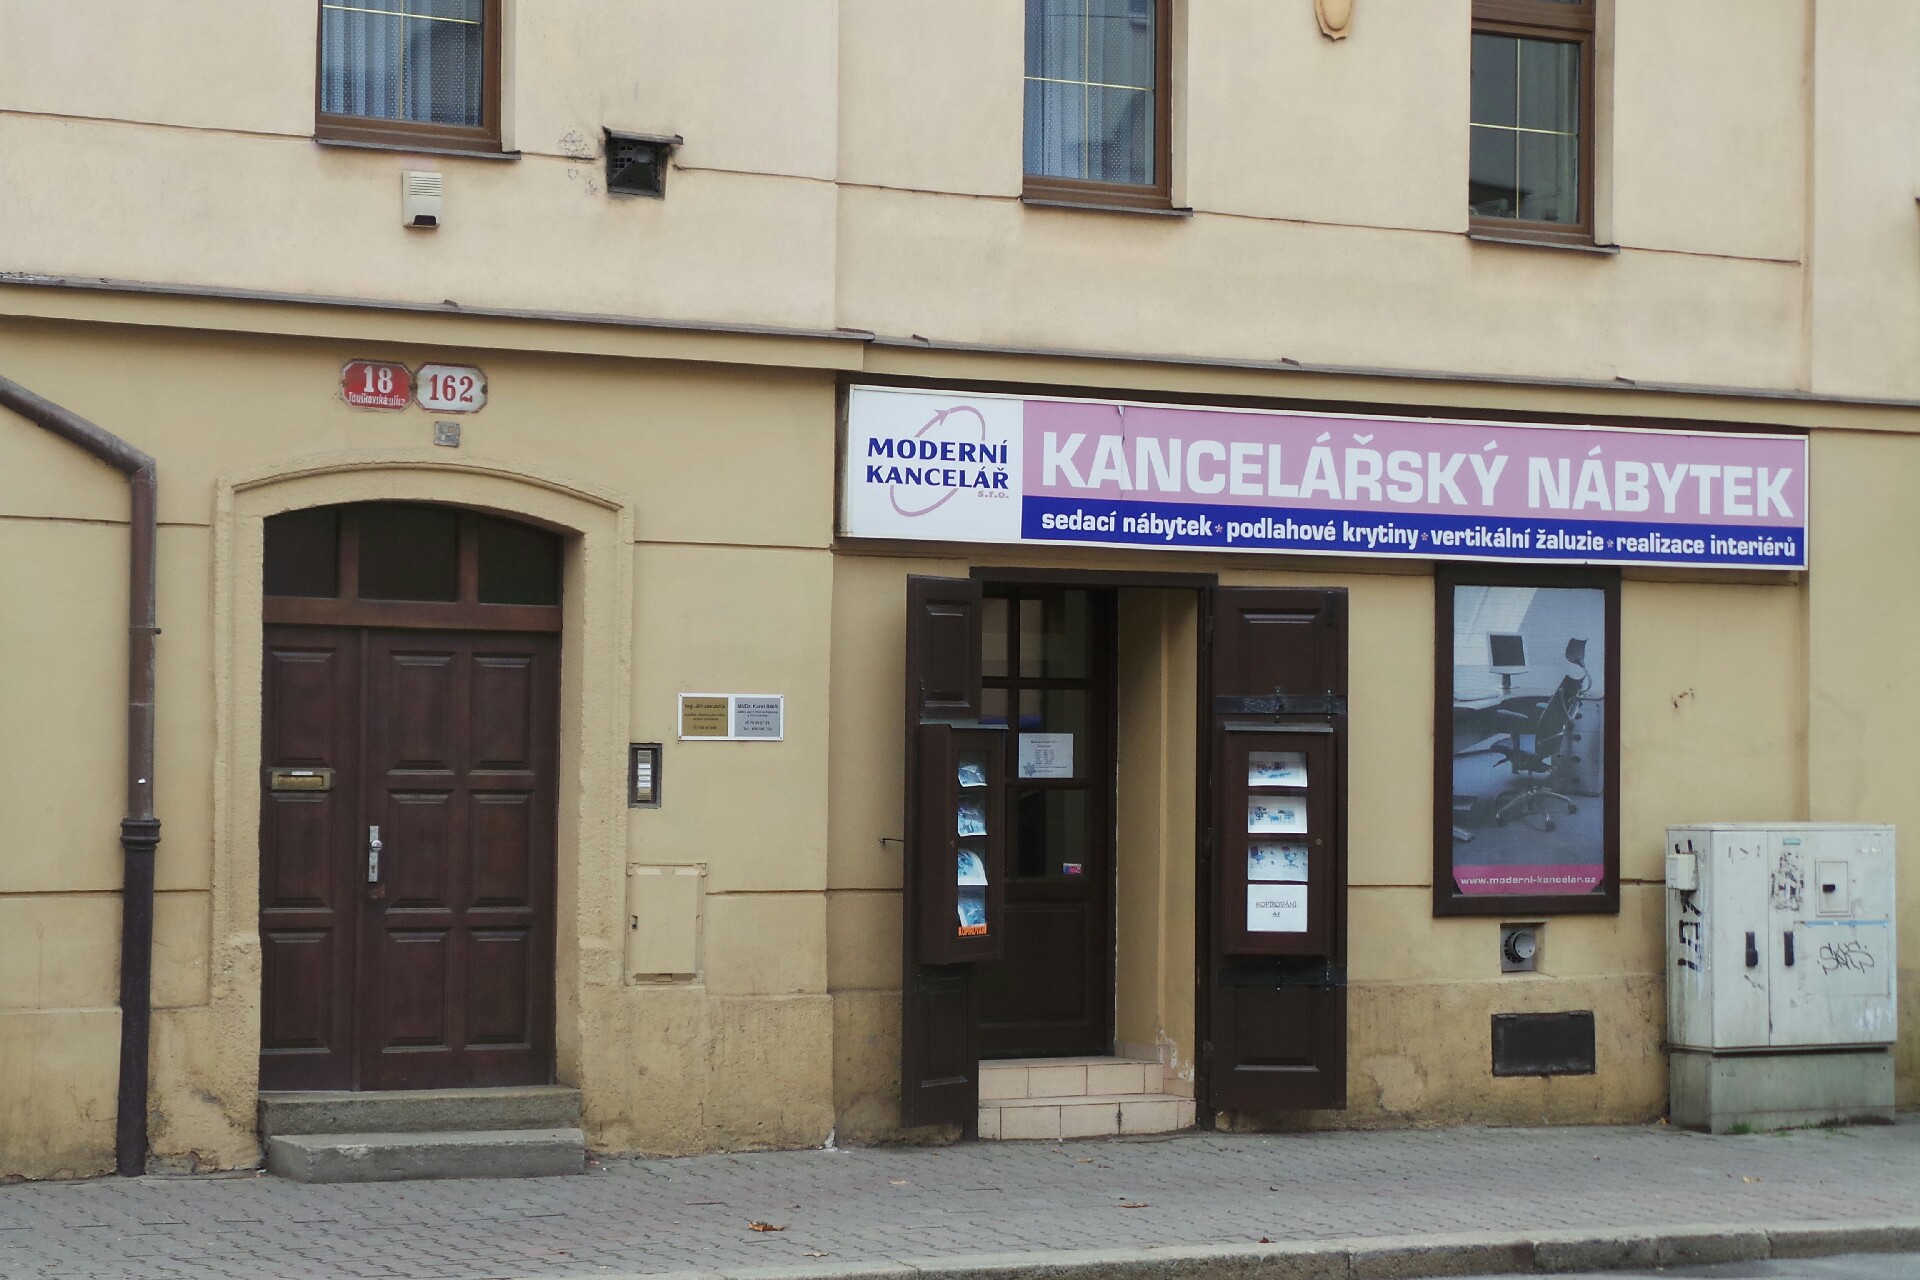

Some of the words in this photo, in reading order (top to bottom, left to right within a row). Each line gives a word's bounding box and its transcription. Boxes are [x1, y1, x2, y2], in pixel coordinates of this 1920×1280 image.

[363, 365, 393, 394] 18
[429, 373, 474, 403] 162
[867, 437, 1008, 464] MODERNÍ
[866, 464, 1009, 489] KANCELÁŘ
[1042, 431, 1509, 506] KANCELÁŘSKÝ
[1528, 445, 1794, 518] NÁBYTEK
[977, 490, 1010, 499] s.r.o.
[1041, 509, 1117, 532] sedací
[1123, 512, 1213, 540] nábytek
[1226, 516, 1336, 543] podlahové
[1342, 521, 1419, 550] krytiny
[1431, 526, 1531, 550] vertikální
[1536, 529, 1604, 551] žaluzie
[1616, 532, 1705, 554] realizace
[1710, 535, 1796, 557] interiérů
[1460, 875, 1596, 885] www.moderni-kancelar.cz
